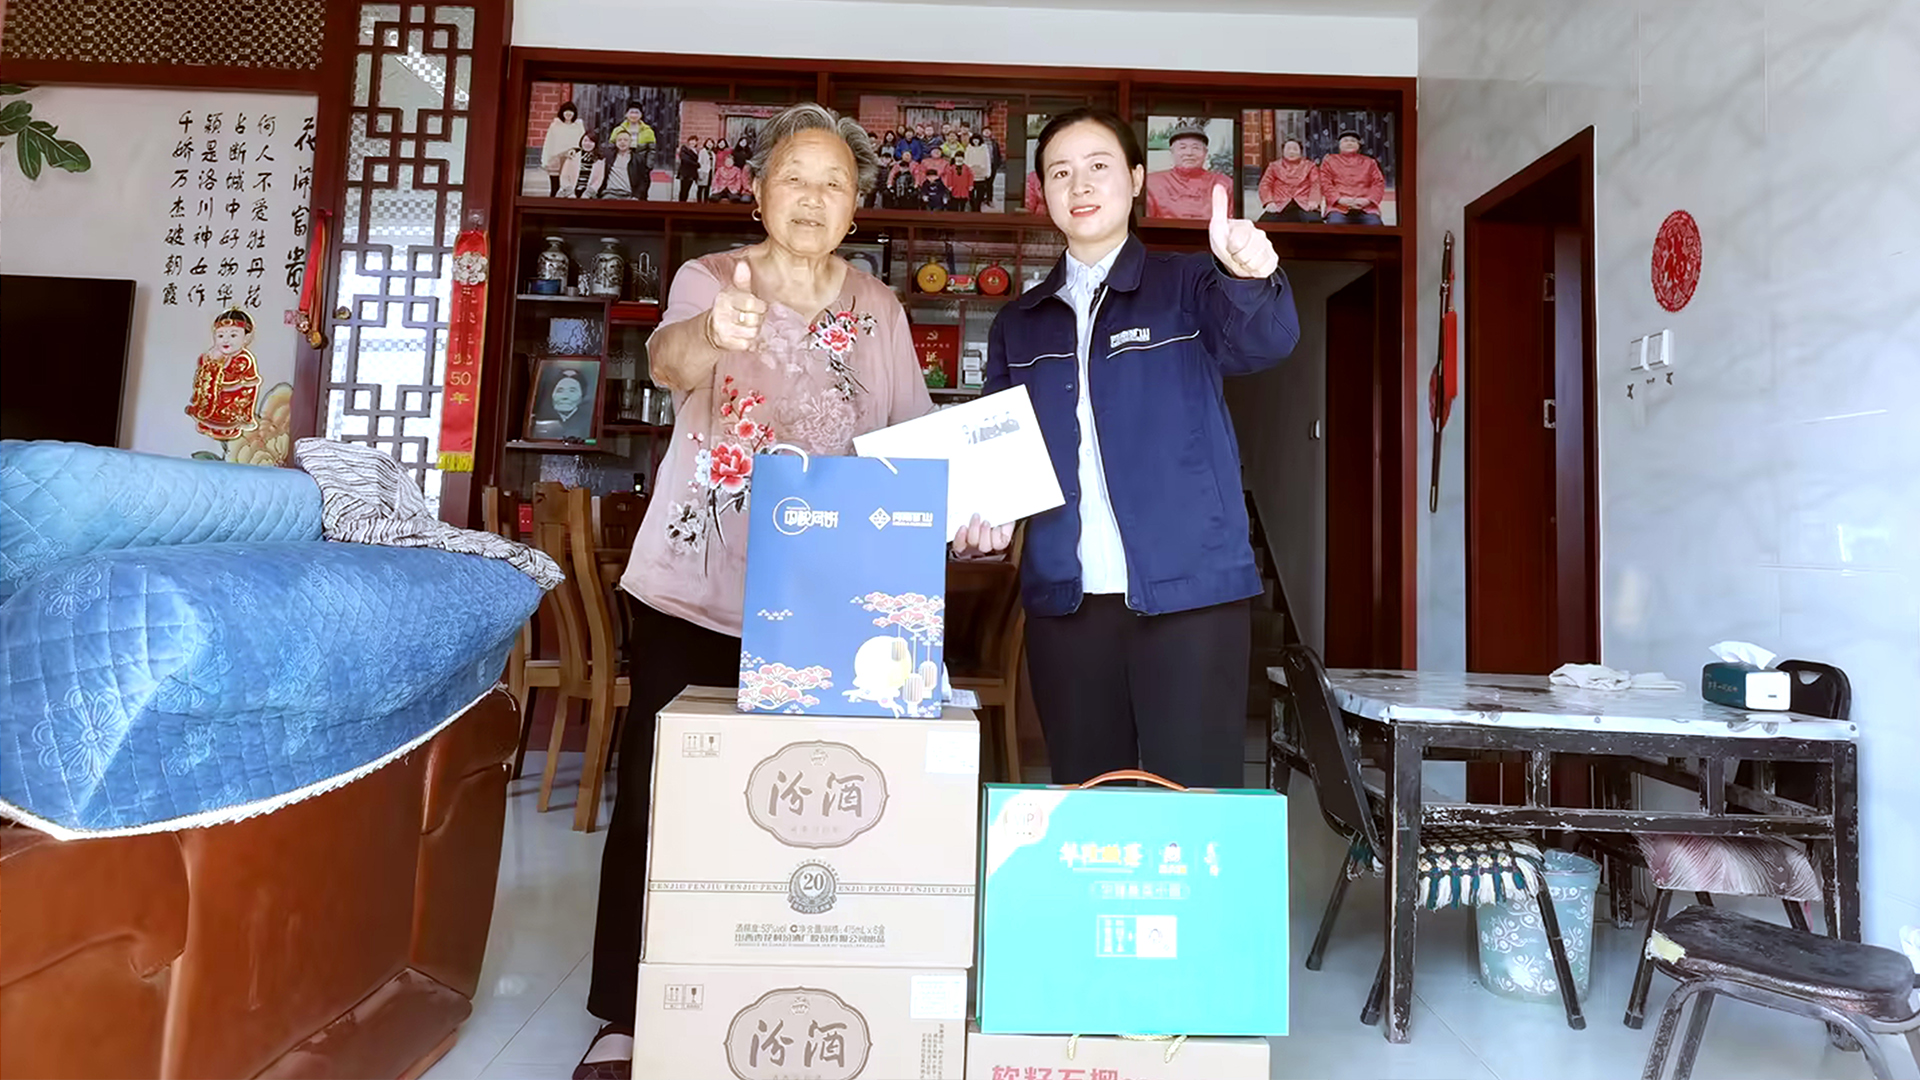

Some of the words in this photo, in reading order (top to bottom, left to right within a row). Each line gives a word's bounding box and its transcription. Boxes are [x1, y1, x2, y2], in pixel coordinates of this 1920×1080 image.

[244, 113, 276, 308] 何人不爱牡丹花
[768, 770, 865, 818] 汾酒
[803, 872, 825, 891] 20
[748, 1018, 848, 1069] 汾酒
